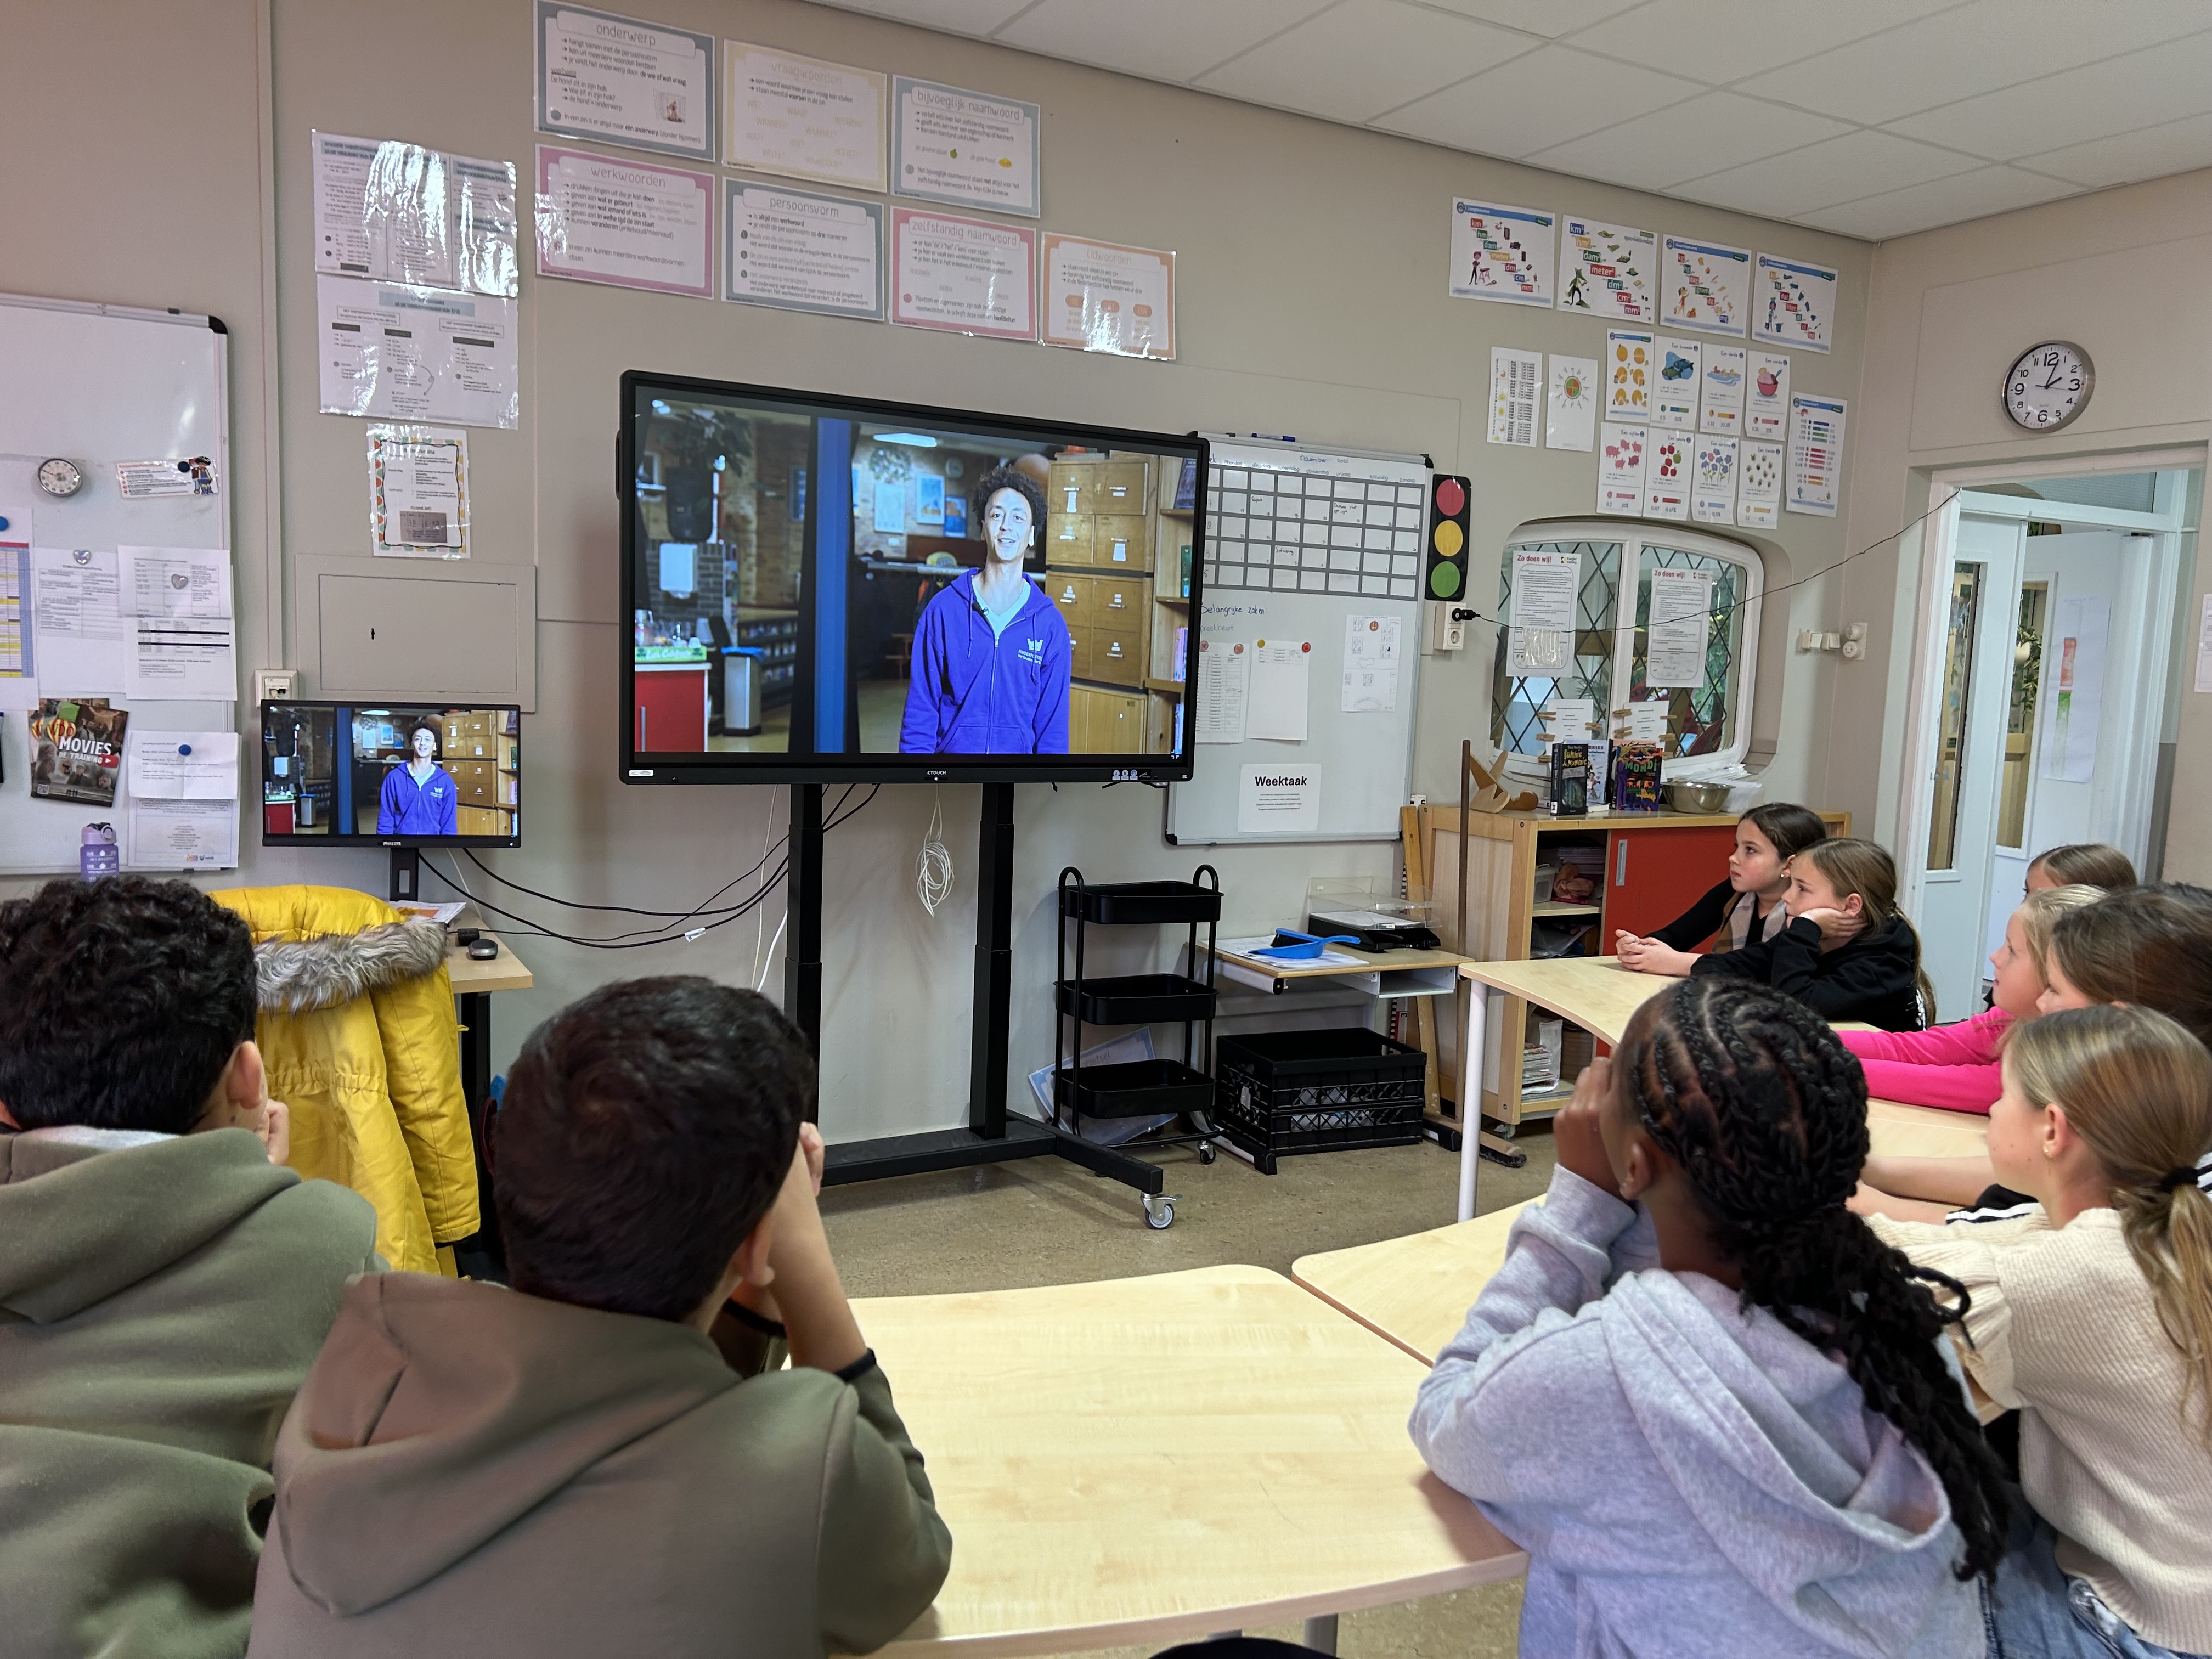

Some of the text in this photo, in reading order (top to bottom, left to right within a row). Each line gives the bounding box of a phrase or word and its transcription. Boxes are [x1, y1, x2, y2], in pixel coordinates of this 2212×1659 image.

[596, 24, 656, 47] onderwerp
[598, 63, 625, 75] onderwerp
[918, 89, 1019, 120] bijvoeglijk naamwoord
[591, 167, 665, 188] werkwoorden
[614, 199, 632, 207] gebeurt
[642, 194, 654, 202] doen
[608, 205, 624, 214] iemand
[770, 198, 839, 217] persoonsvorm
[591, 221, 618, 230] veranderen
[912, 221, 1016, 245] zelfstandig naamwoord
[1491, 252, 1509, 261] meter
[2034, 358, 2039, 366] 11
[2044, 352, 2059, 366] 12
[2064, 355, 2067, 363] 1
[2020, 369, 2029, 377] 10
[2070, 365, 2078, 373] 2
[2015, 383, 2024, 395] 9
[2068, 379, 2080, 391] 3
[2024, 412, 2030, 422] 7
[2038, 410, 2047, 422] 6
[59, 736, 112, 755] MOVIES
[70, 753, 103, 764] TRAINING
[1255, 776, 1307, 786] Weektaak
